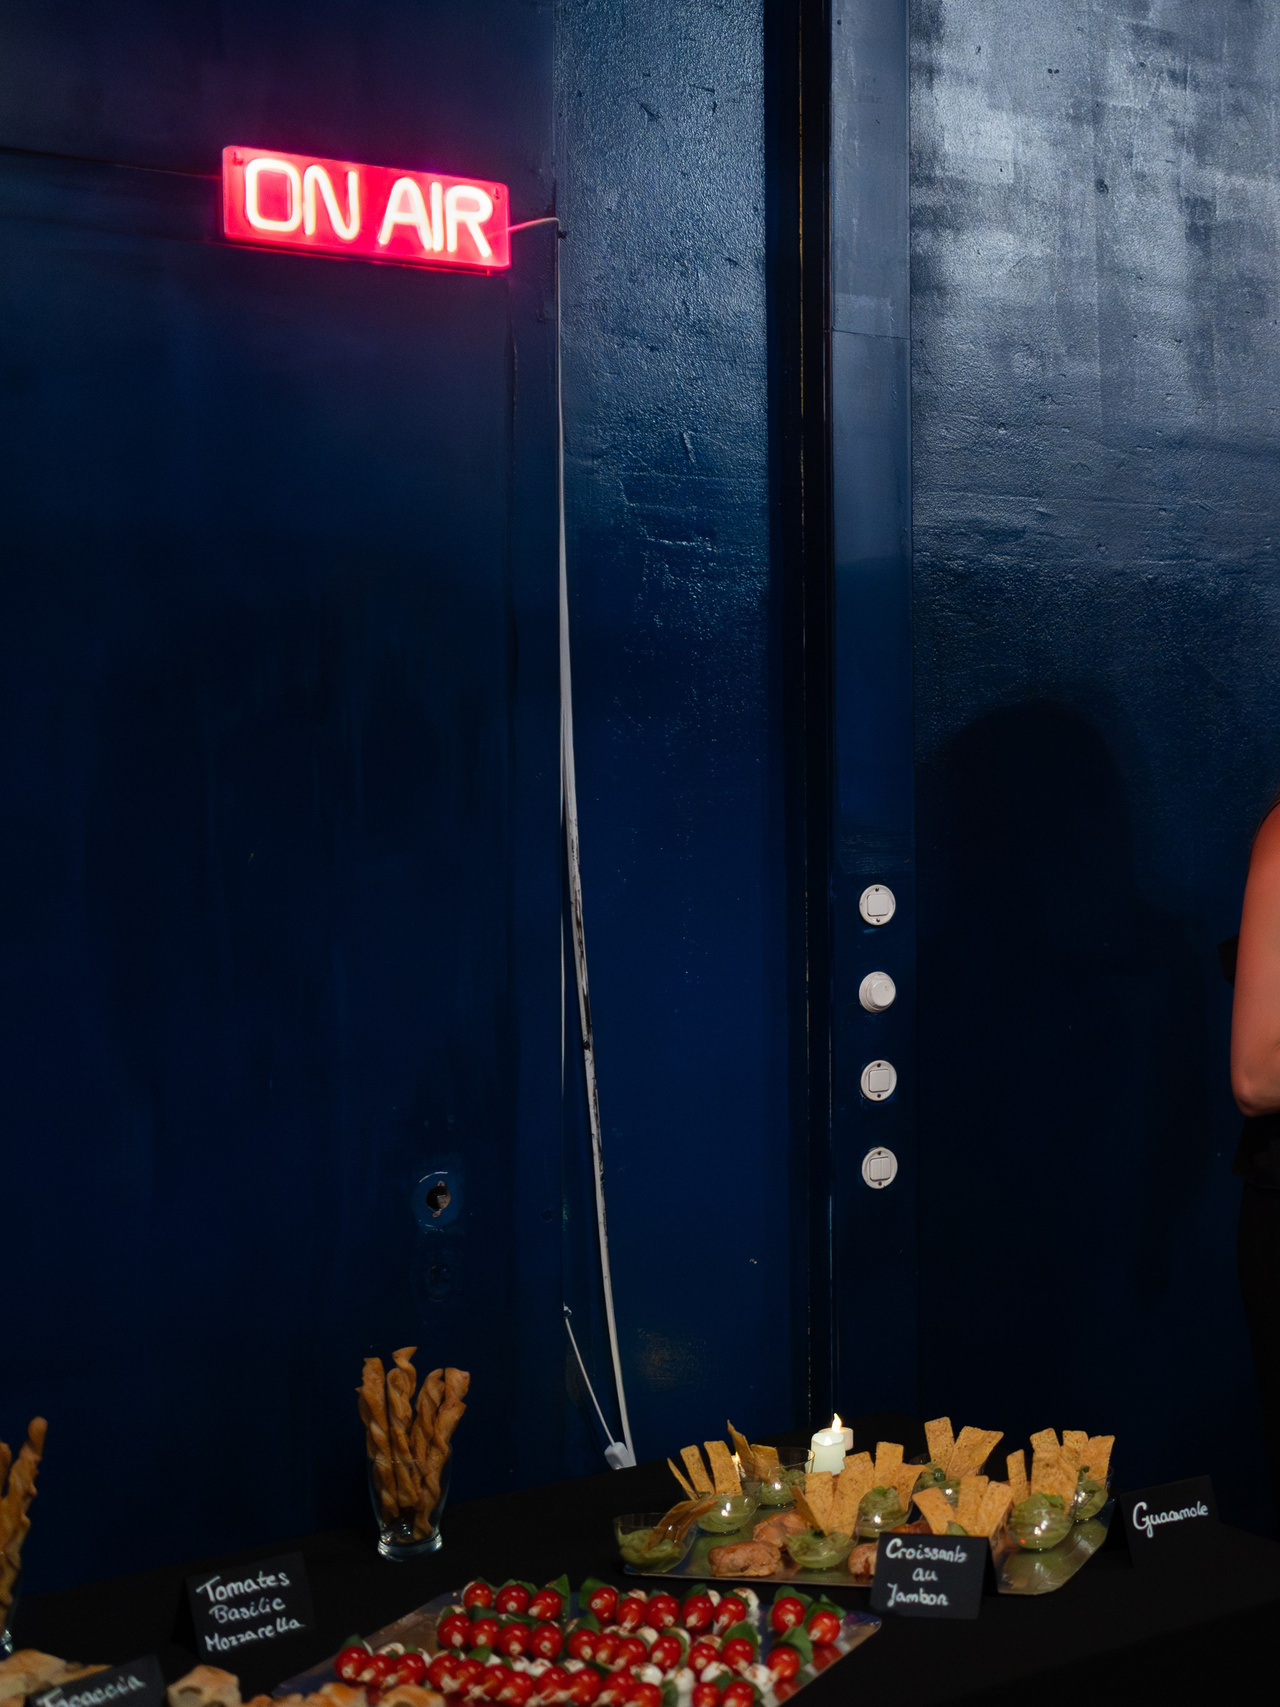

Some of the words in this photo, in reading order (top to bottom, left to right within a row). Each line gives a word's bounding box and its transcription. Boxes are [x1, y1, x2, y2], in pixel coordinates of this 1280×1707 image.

[245, 158, 360, 240] ON
[377, 176, 493, 257] AIR
[196, 1571, 290, 1602] Tomates
[912, 1568, 938, 1581] au
[887, 1583, 949, 1607] Jambon
[209, 1597, 286, 1623] Basilic
[204, 1617, 307, 1651] Mozzarella
